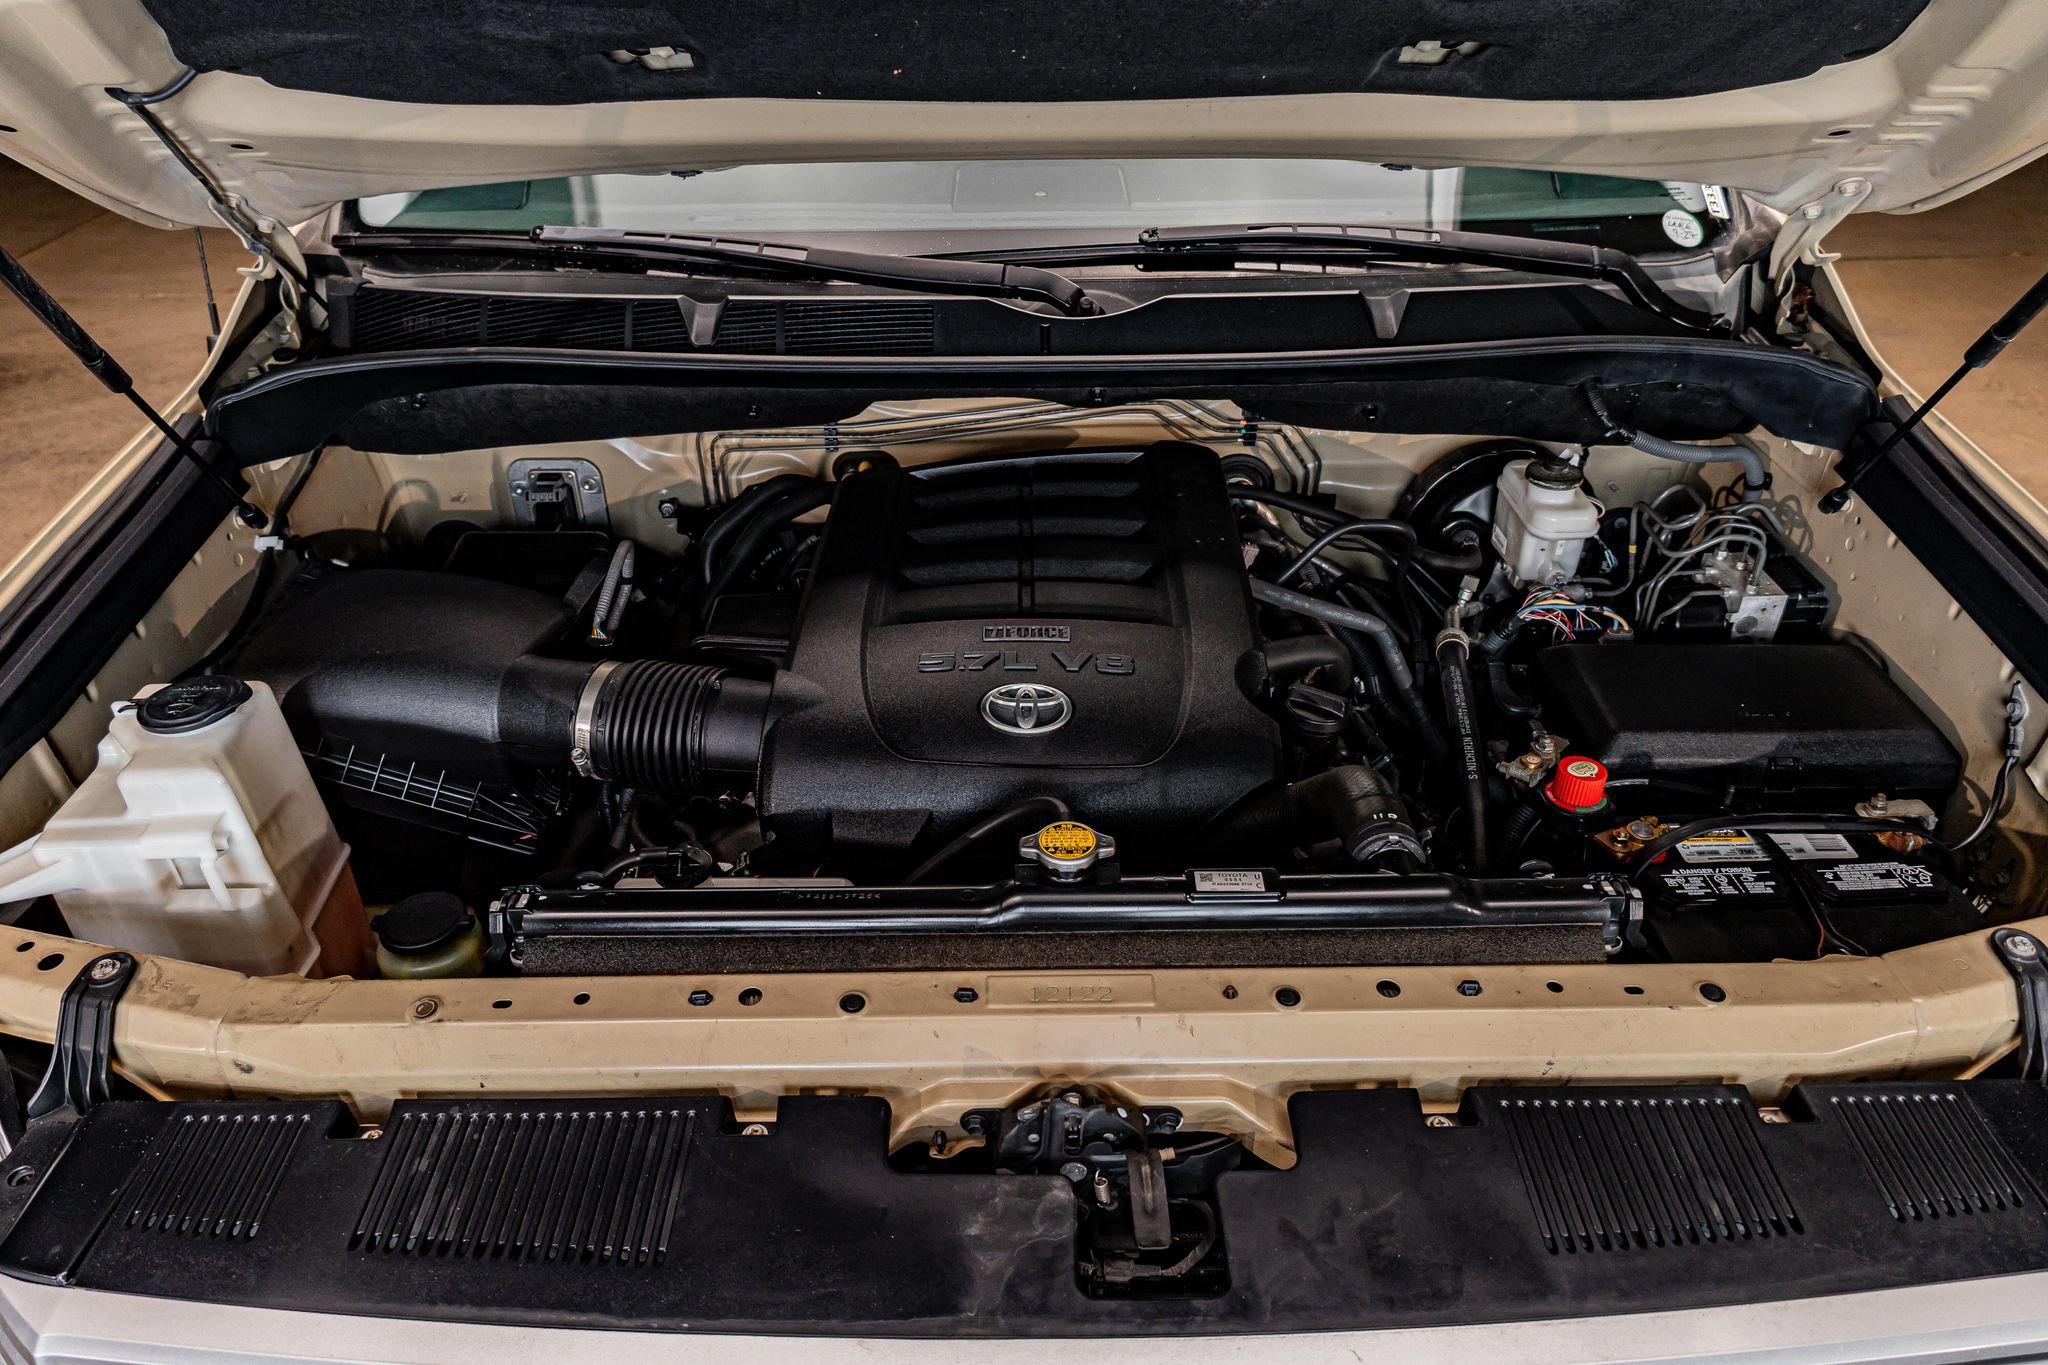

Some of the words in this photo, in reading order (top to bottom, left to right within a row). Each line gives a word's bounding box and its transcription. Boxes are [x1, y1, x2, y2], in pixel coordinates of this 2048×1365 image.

[918, 651, 1038, 673] 5.7L
[1051, 652, 1135, 675] V8
[1031, 985, 1113, 1002] 12122
